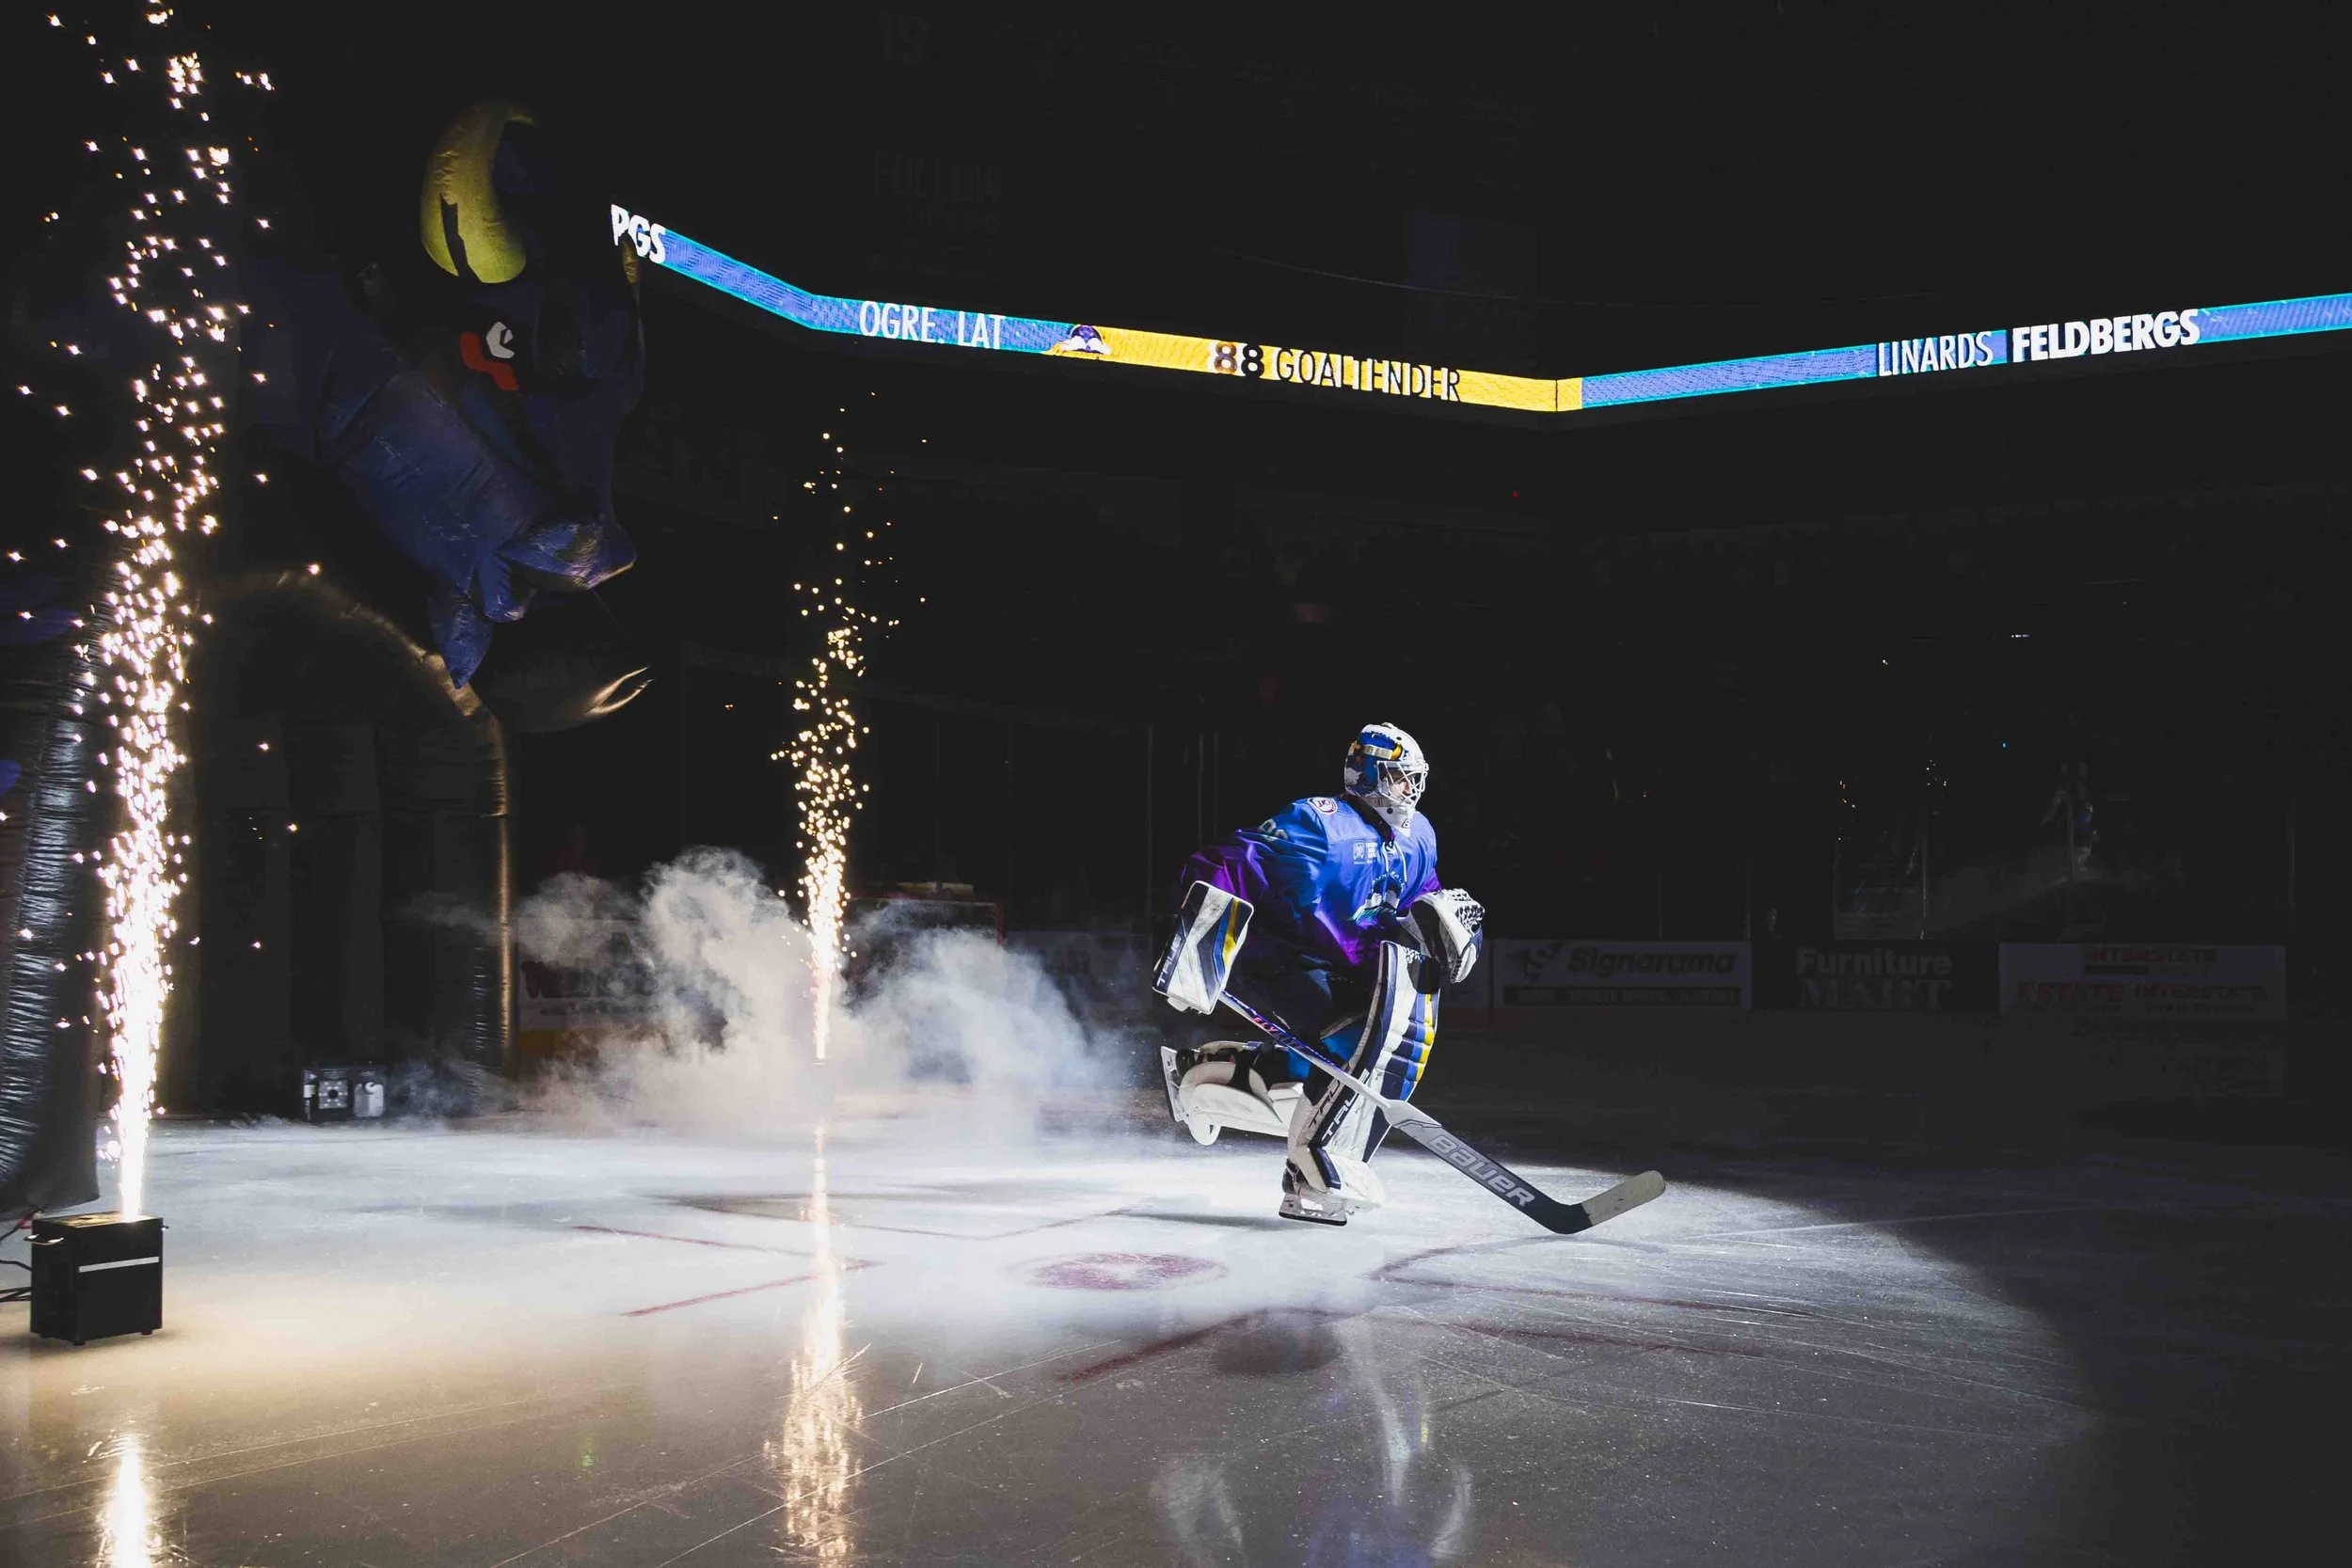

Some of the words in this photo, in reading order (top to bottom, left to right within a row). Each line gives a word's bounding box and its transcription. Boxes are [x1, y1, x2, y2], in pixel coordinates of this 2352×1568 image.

[957, 310, 1006, 350] LAT
[1878, 330, 1993, 377] LINARDS
[2011, 309, 2201, 363] FELDBERGS
[1214, 341, 1264, 377] 88
[1277, 347, 1459, 402] GOALTENDER
[1156, 933, 1182, 987] TRUE
[1567, 947, 1737, 978] Signarama
[1796, 945, 1953, 975] Furniture
[1797, 977, 1952, 1009] MART
